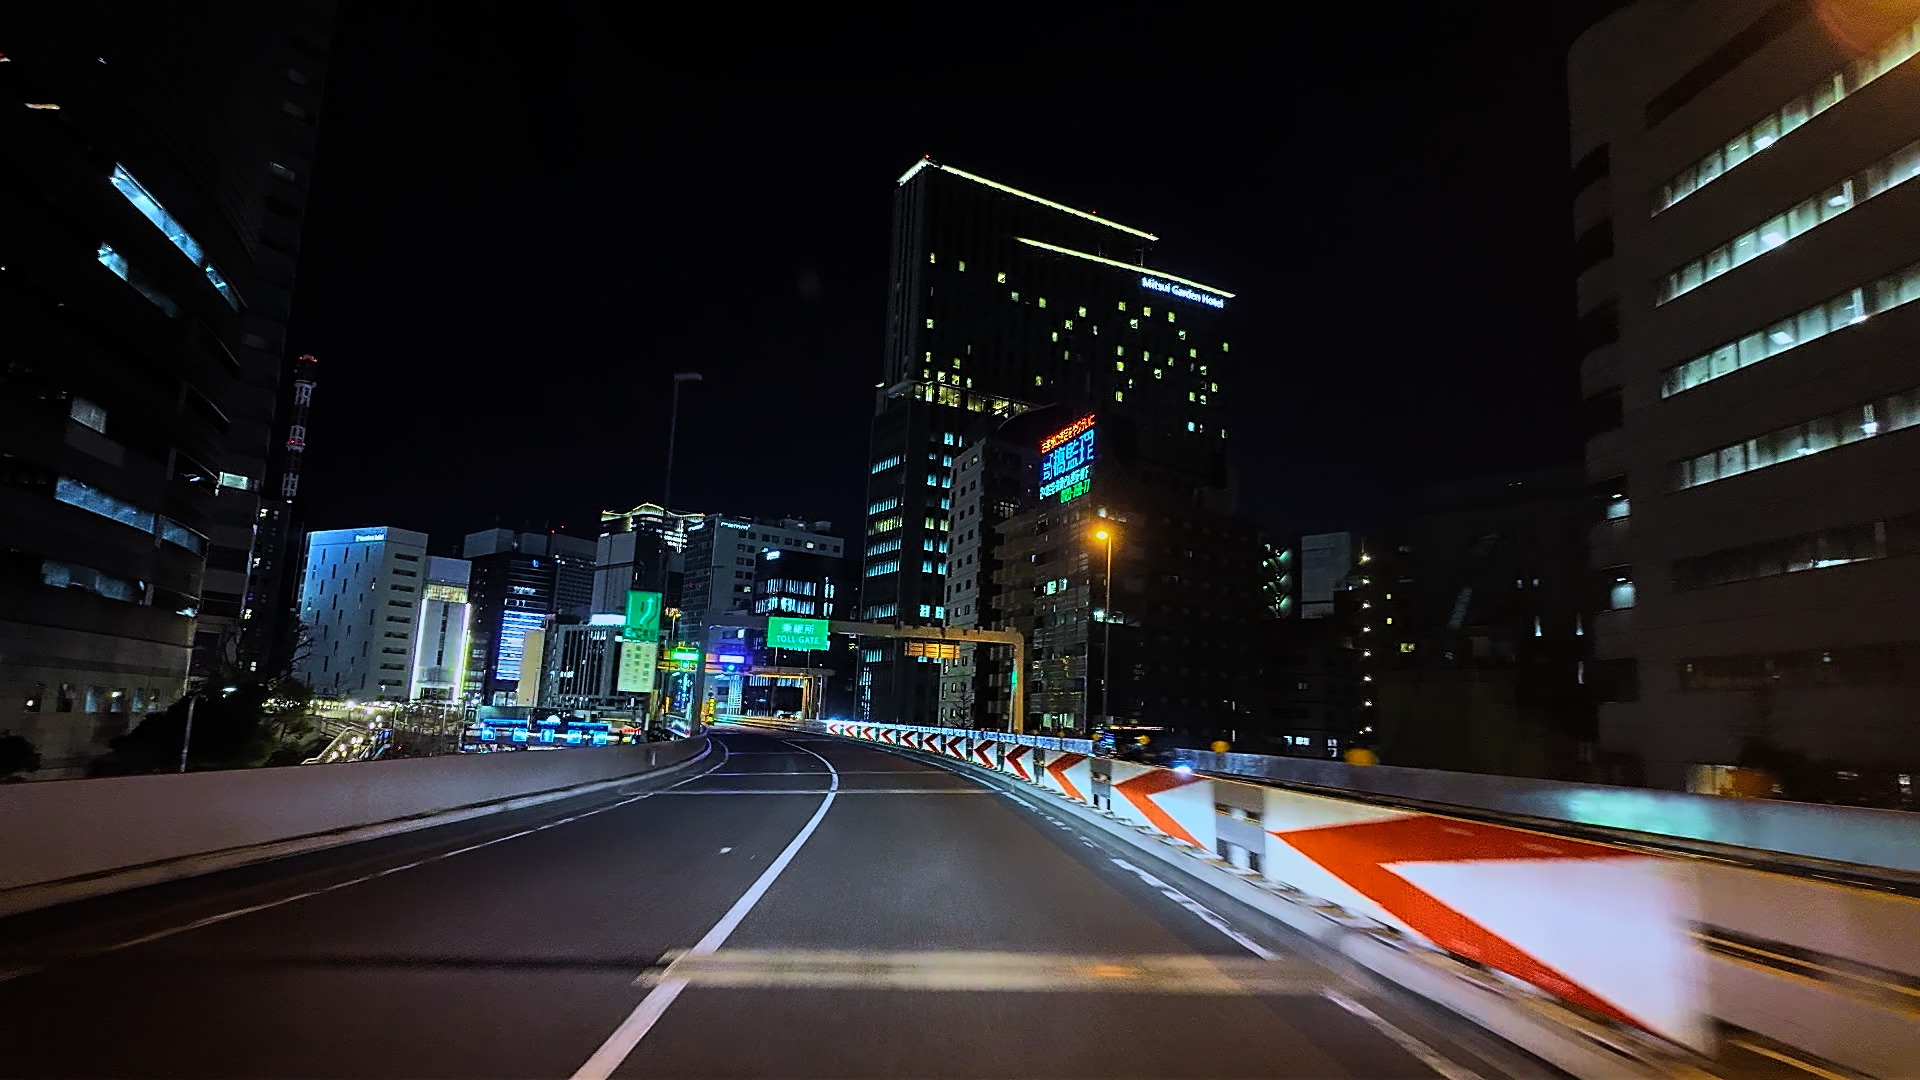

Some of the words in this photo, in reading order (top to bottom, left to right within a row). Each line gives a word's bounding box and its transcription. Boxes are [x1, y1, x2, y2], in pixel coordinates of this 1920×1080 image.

[1142, 277, 1170, 293] Mitsui
[1171, 285, 1201, 302] Garden
[1202, 294, 1223, 308] Hotel
[776, 635, 795, 643] TOLL
[798, 636, 819, 644] GATE
